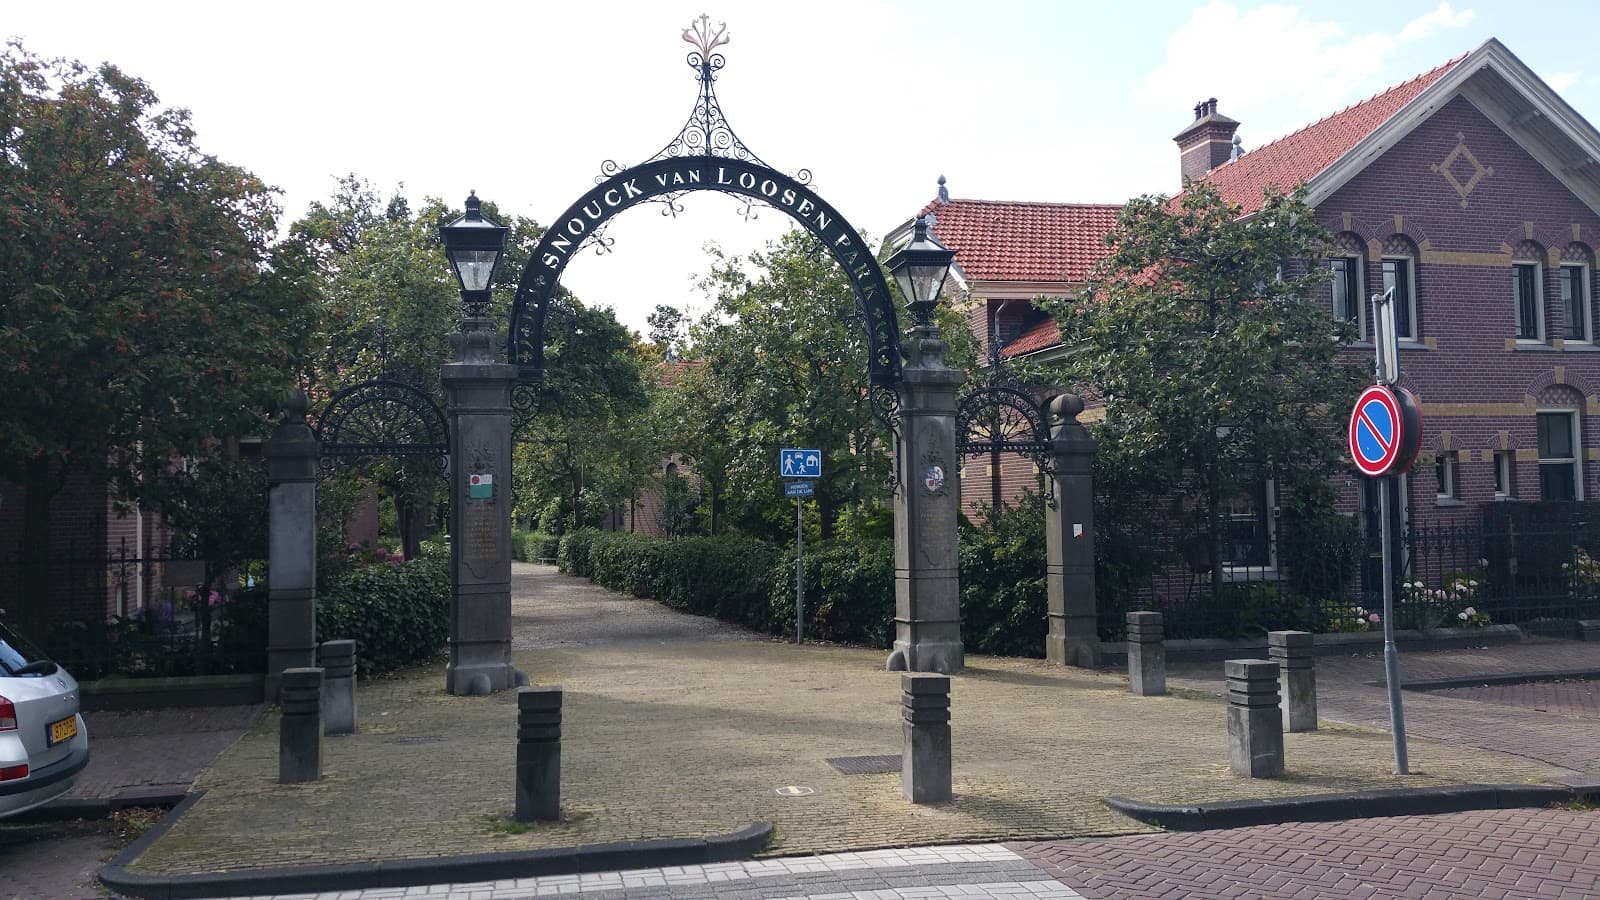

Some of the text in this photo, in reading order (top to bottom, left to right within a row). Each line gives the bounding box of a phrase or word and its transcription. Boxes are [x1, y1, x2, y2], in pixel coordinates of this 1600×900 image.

[541, 167, 880, 301] SNOUCK VAN LOOSEN PARK
